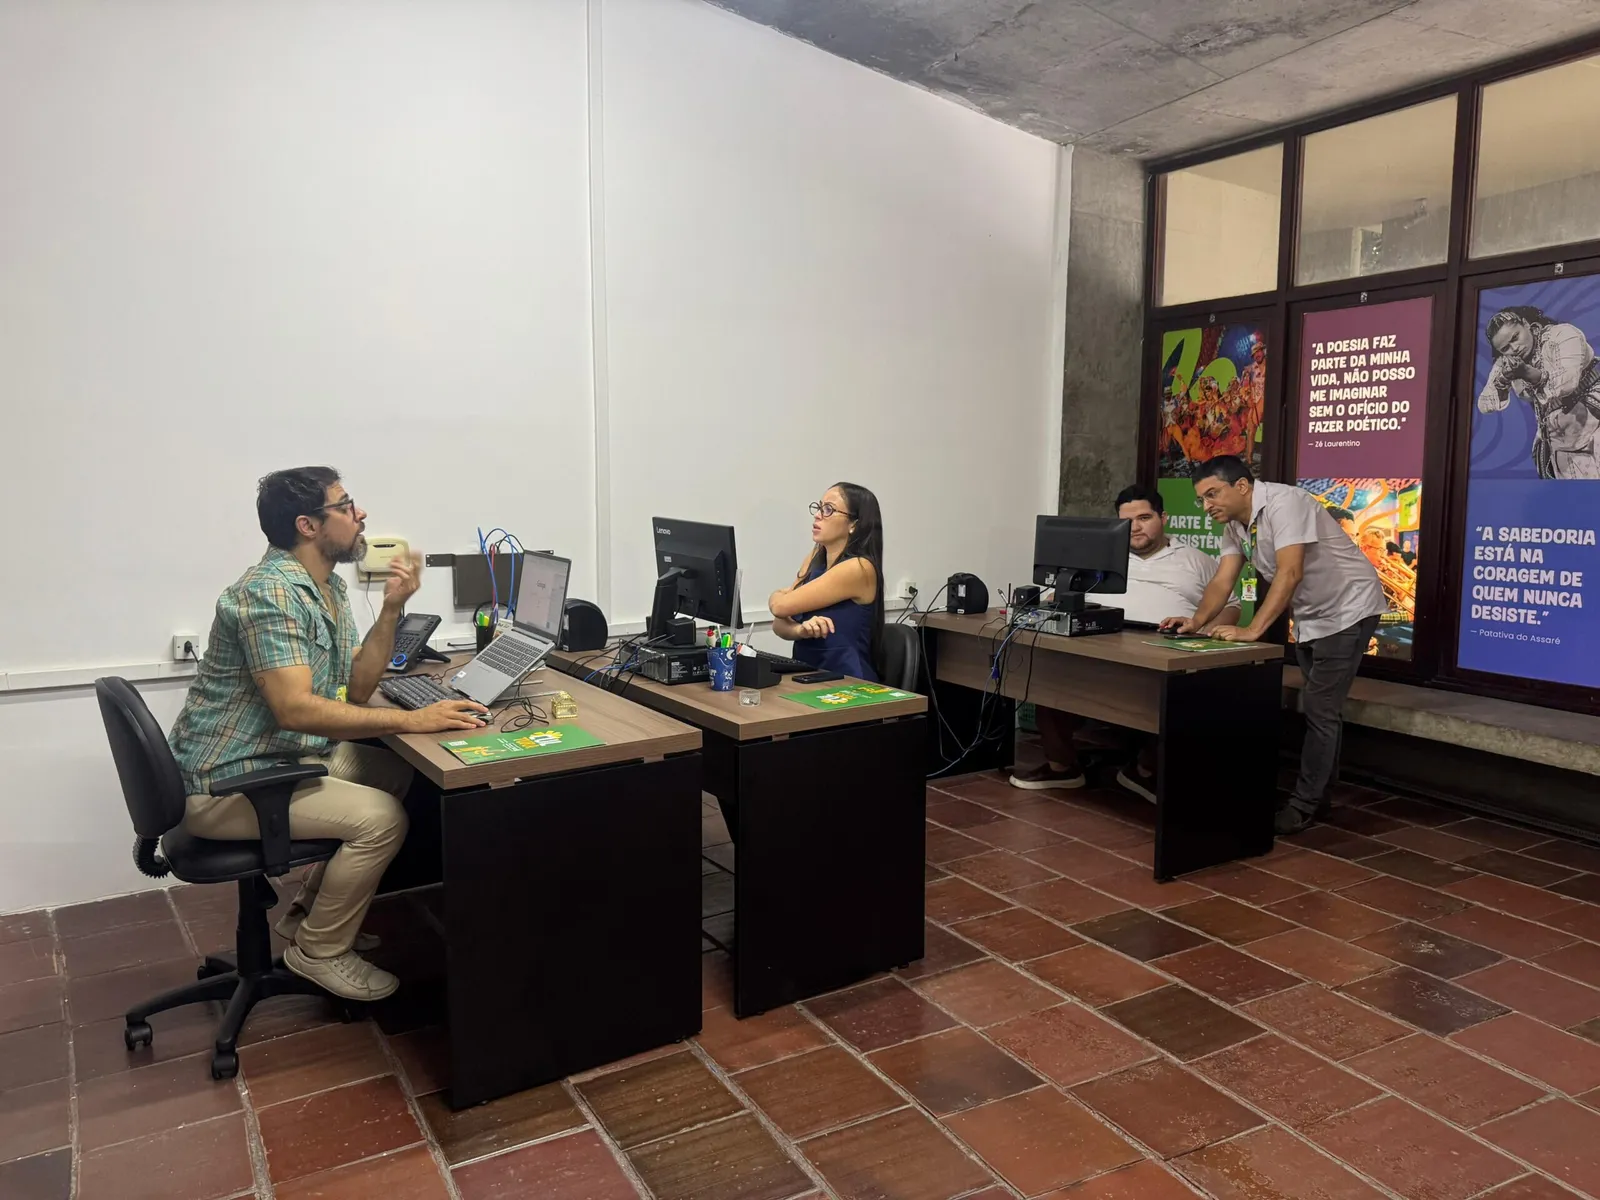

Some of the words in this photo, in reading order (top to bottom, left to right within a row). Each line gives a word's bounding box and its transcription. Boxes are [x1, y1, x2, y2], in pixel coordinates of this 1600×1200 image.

[1327, 337, 1369, 354] POESIA
[1372, 334, 1397, 349] FAZ
[1311, 356, 1347, 371] PARTE
[1350, 354, 1367, 367] DA
[1370, 350, 1411, 366] MINHA
[1310, 373, 1341, 387] VIDA,
[1343, 367, 1369, 385] NÃO
[1372, 366, 1416, 382] POSSO
[1309, 389, 1327, 402] ME
[1329, 385, 1388, 401] IMAGINAR
[1309, 404, 1333, 418] SEM
[1336, 404, 1345, 416] O
[1348, 399, 1388, 416] OFÍCIO
[1391, 400, 1410, 414] DO
[1308, 420, 1344, 433] FAZER
[1315, 440, 1323, 448] Zé
[1324, 439, 1361, 448] Laurentino
[656, 526, 671, 535] Lenovo
[1204, 513, 1213, 530] É
[1498, 526, 1596, 546] SABEDORIA
[1474, 543, 1515, 562] ESTÁ
[1520, 548, 1544, 564] NA
[1473, 565, 1555, 585] CORAGEM
[1560, 571, 1583, 587] DE
[1472, 585, 1518, 603] QUEM
[1523, 589, 1583, 609] NUNCA
[1471, 604, 1550, 625] DESISTE.”
[1479, 629, 1515, 641] Patativa
[1516, 633, 1528, 641] do
[1530, 635, 1561, 645] Assaré
